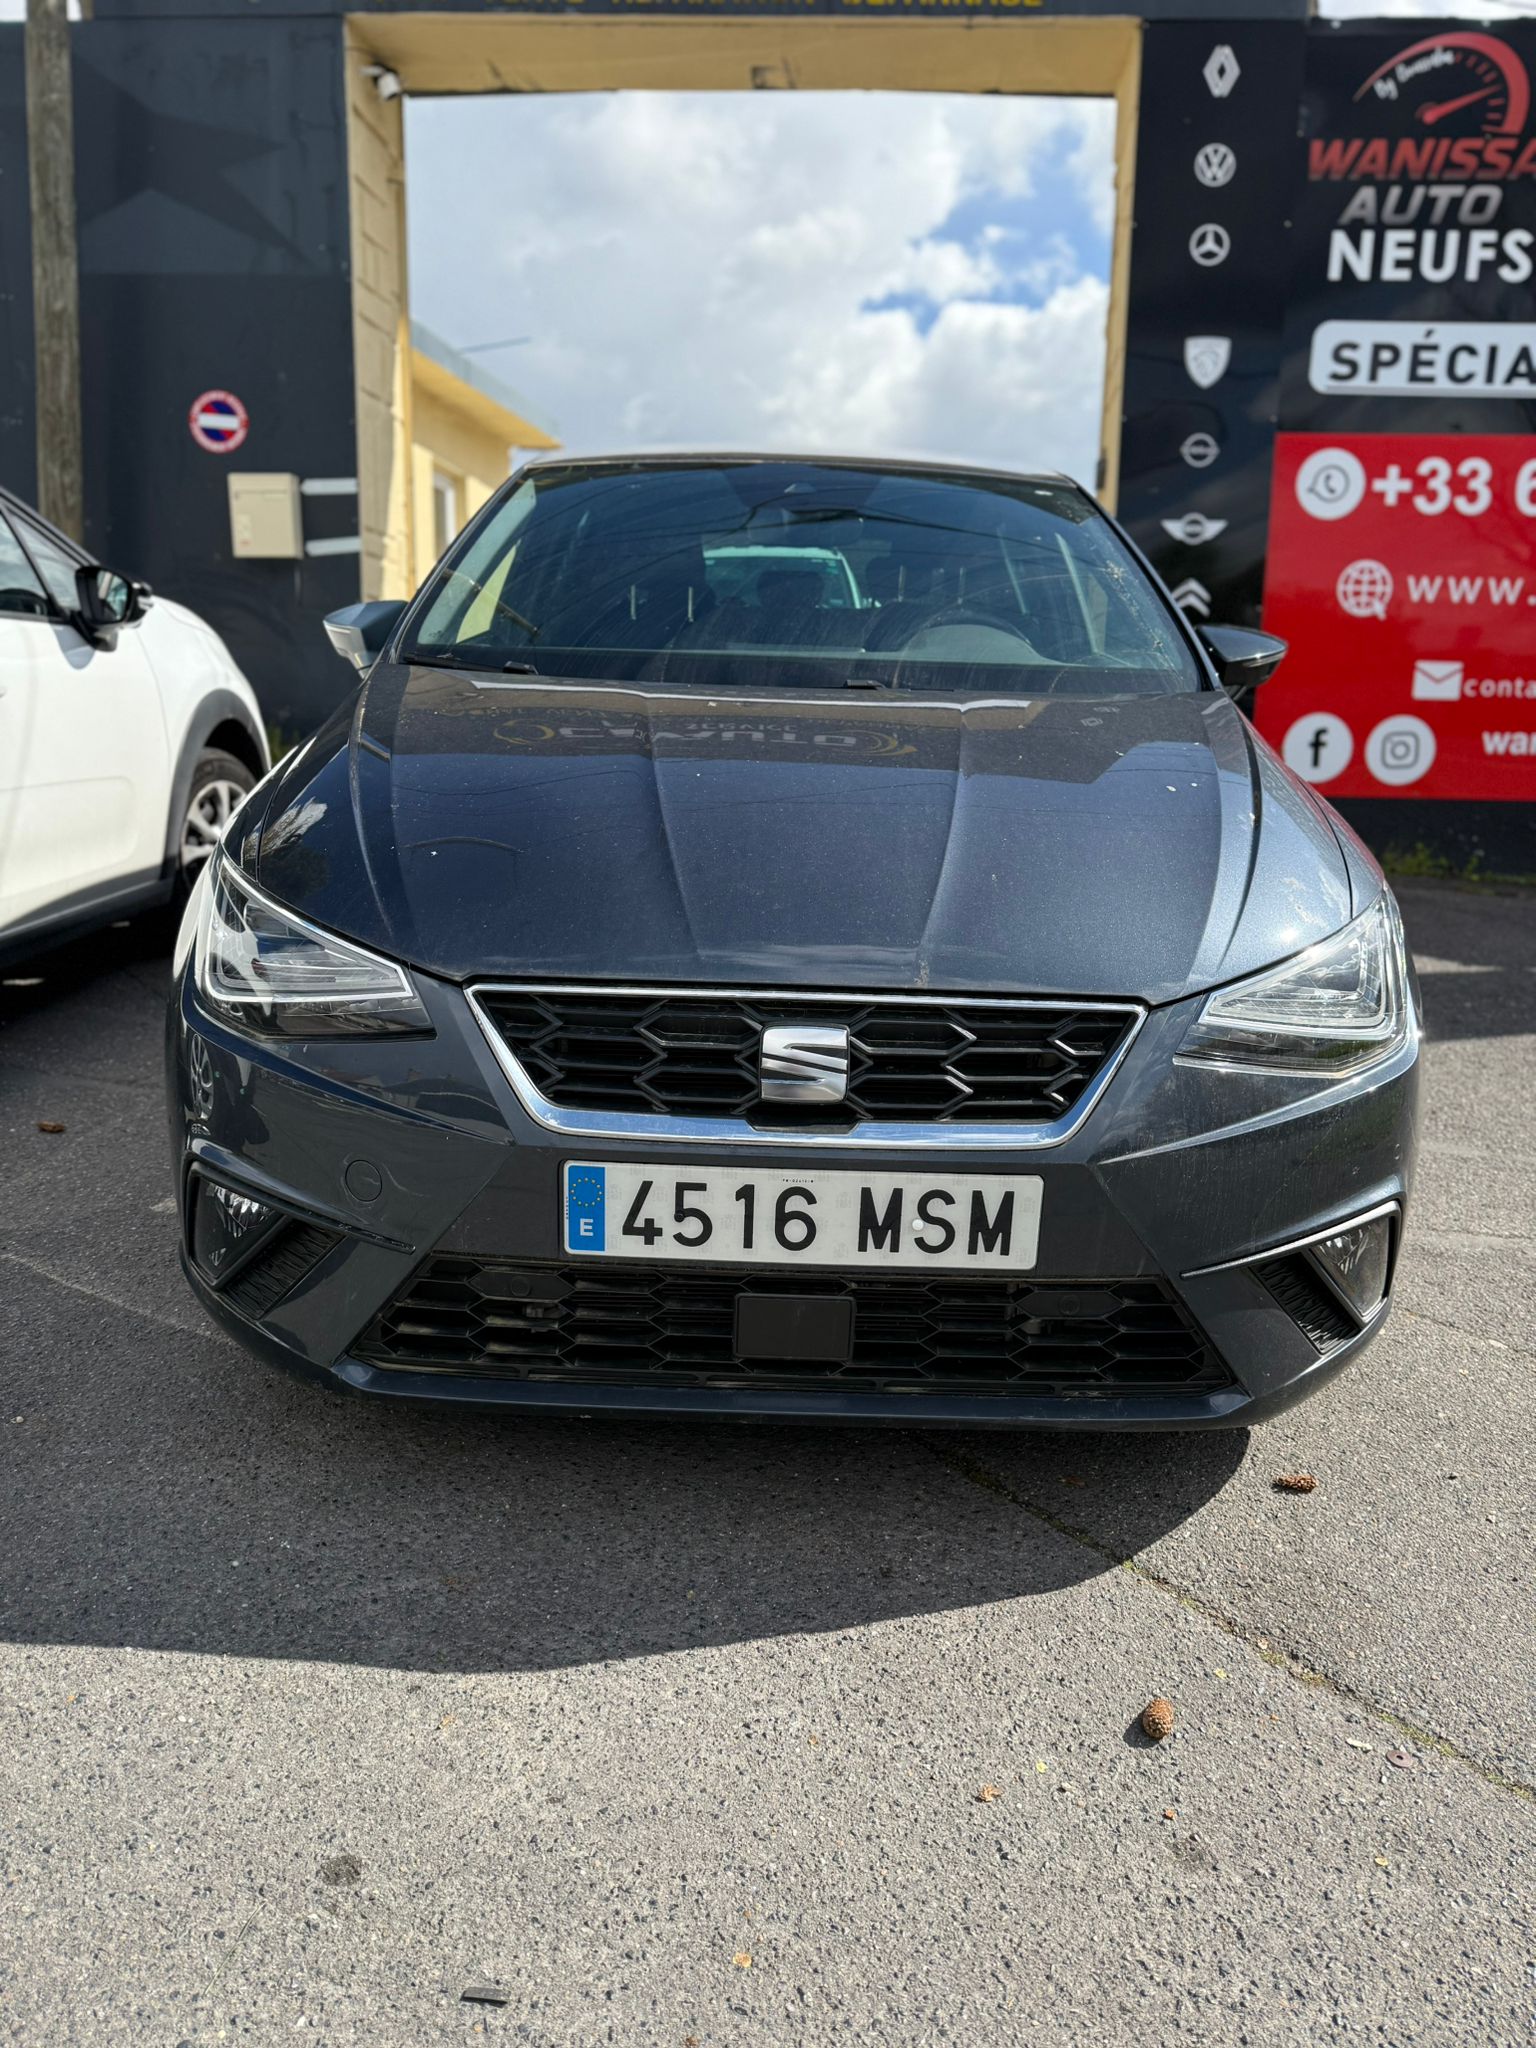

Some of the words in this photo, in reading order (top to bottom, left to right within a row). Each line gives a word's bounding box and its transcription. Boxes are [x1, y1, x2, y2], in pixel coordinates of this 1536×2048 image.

[1308, 138, 1536, 181] WANISSA
[1338, 184, 1503, 225] AUTO
[1327, 229, 1534, 283] NEUFS
[1329, 328, 1536, 385] SPÉCIA
[1372, 456, 1492, 517] +33
[580, 1218, 594, 1236] E
[621, 1180, 818, 1251] 4516
[858, 1187, 1015, 1256] MSM
